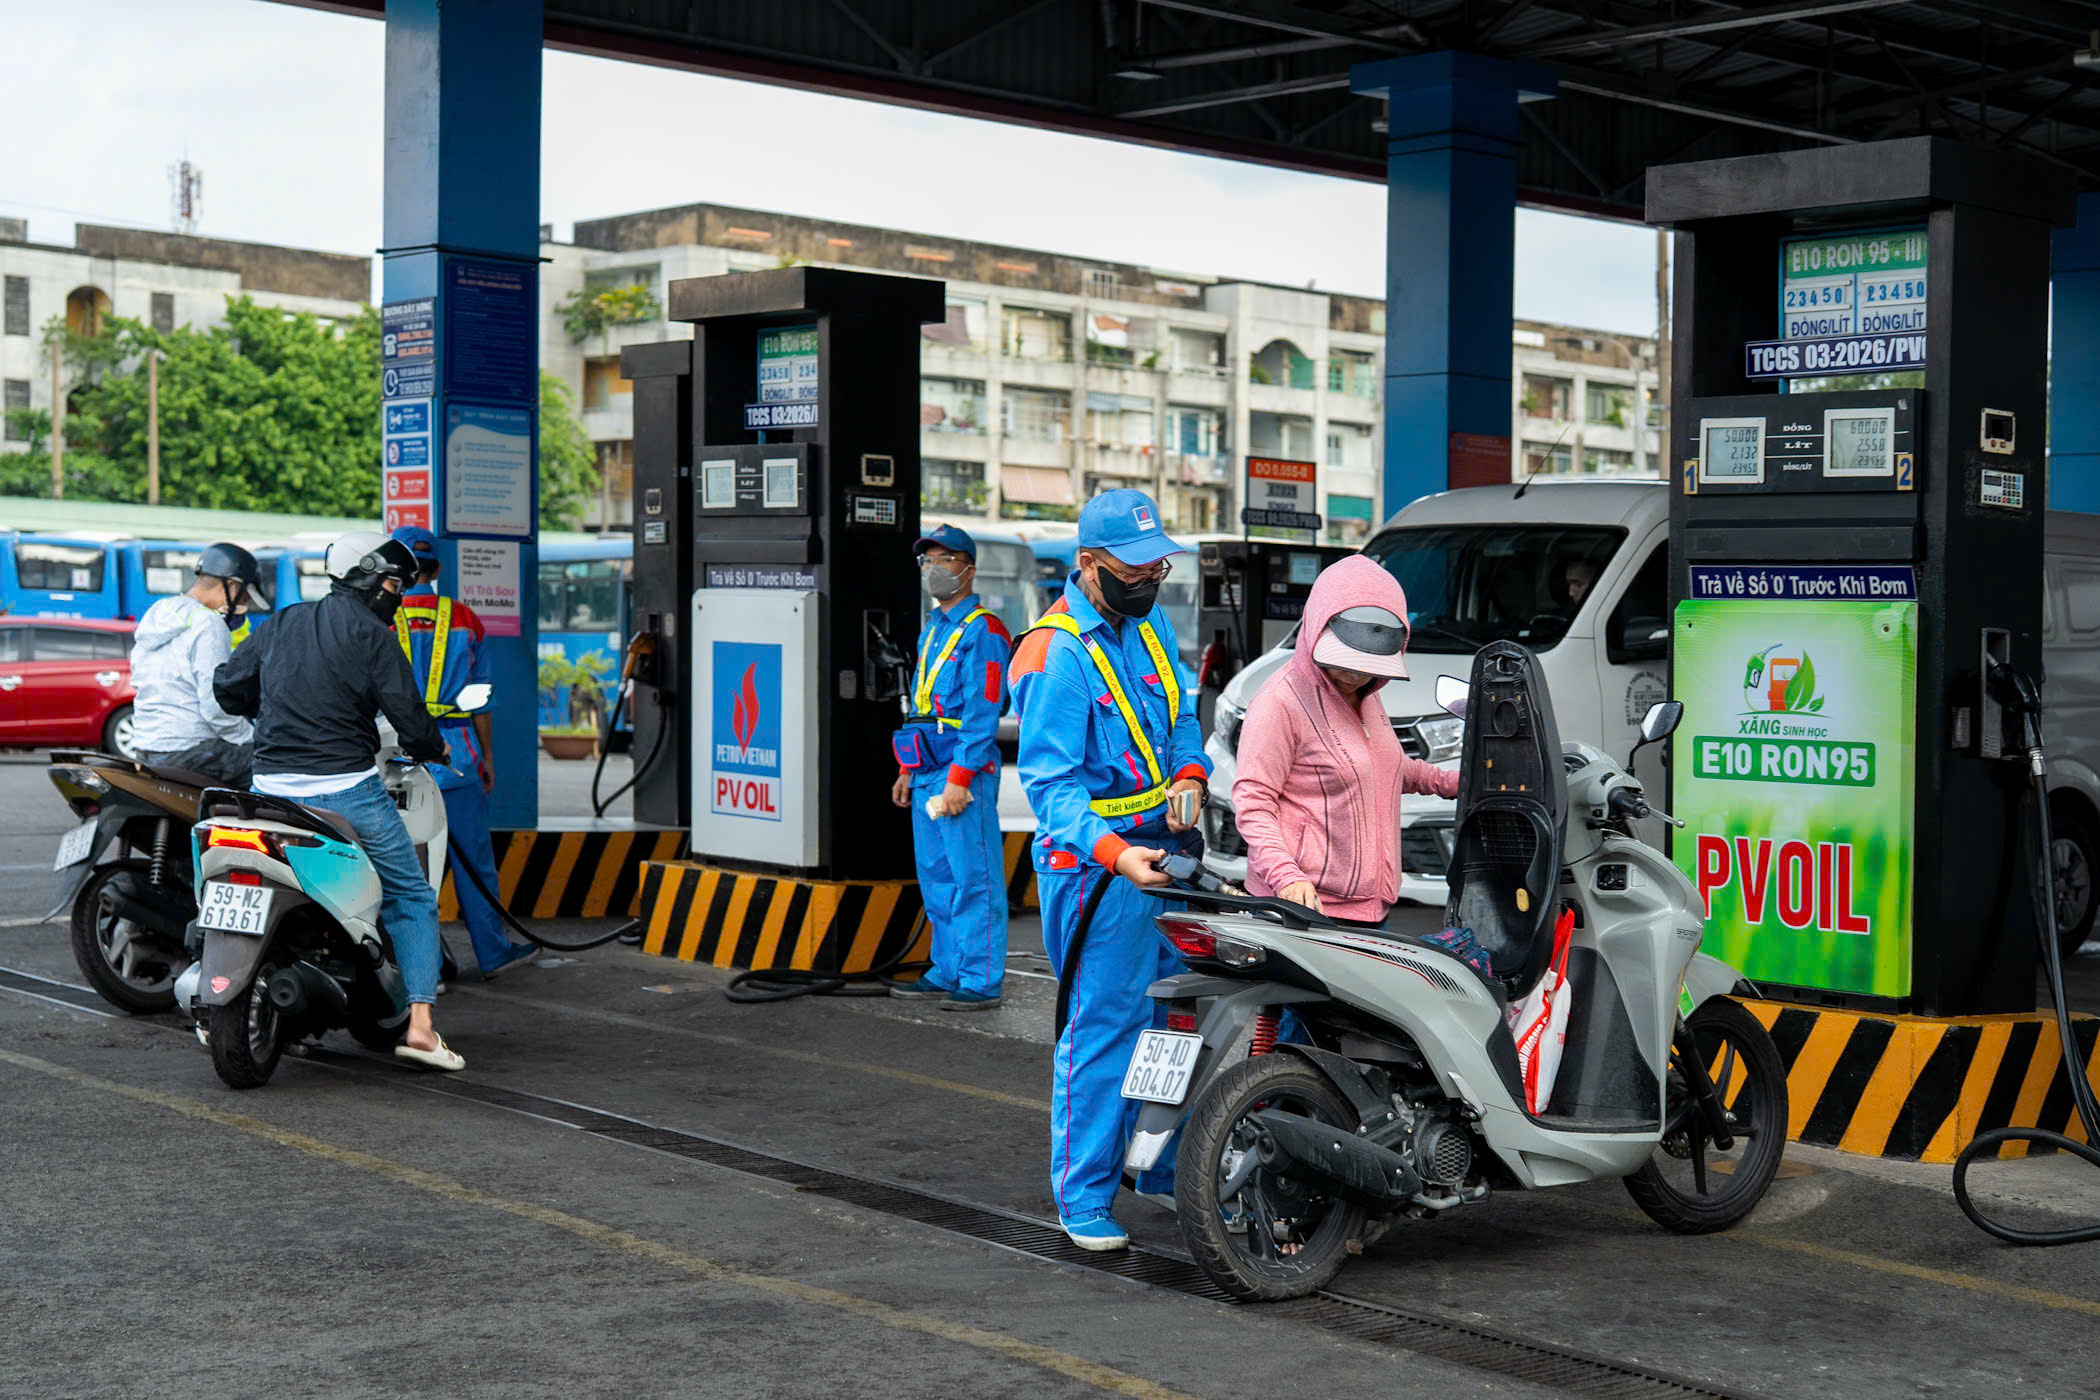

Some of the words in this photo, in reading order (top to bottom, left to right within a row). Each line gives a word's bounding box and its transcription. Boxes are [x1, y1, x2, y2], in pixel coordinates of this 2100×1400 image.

[1792, 247, 1821, 272] E10
[1826, 242, 1864, 269] RON
[1868, 239, 1891, 265] 95
[1905, 237, 1922, 262] III
[1786, 287, 1843, 308] 23450
[1867, 281, 1926, 302] 23450
[1751, 345, 1801, 373] TCCS
[747, 406, 770, 426] TCCS
[1685, 465, 1695, 492] 1
[1900, 457, 1912, 487] 2
[1698, 575, 1722, 595] Trả
[1725, 571, 1745, 595] Về
[1748, 571, 1769, 595] Số
[1789, 576, 1837, 596] Trước
[1839, 576, 1866, 596] Khi
[1869, 576, 1908, 596] Bơm
[484, 599, 515, 608] MoMo
[1150, 641, 1165, 664] RON
[1106, 671, 1120, 693] RON
[1738, 716, 1781, 736] XĂNG
[1782, 725, 1806, 737] SINH
[1807, 727, 1829, 740] HỌC
[716, 743, 777, 768] PETROVIETNAM
[1702, 741, 1753, 775] E10
[1106, 801, 1122, 813] Tiết
[1124, 800, 1143, 812] kiệm
[203, 905, 262, 932] 613.61
[1143, 1035, 1191, 1067] 50-AD
[1129, 1066, 1186, 1099] 604.07
